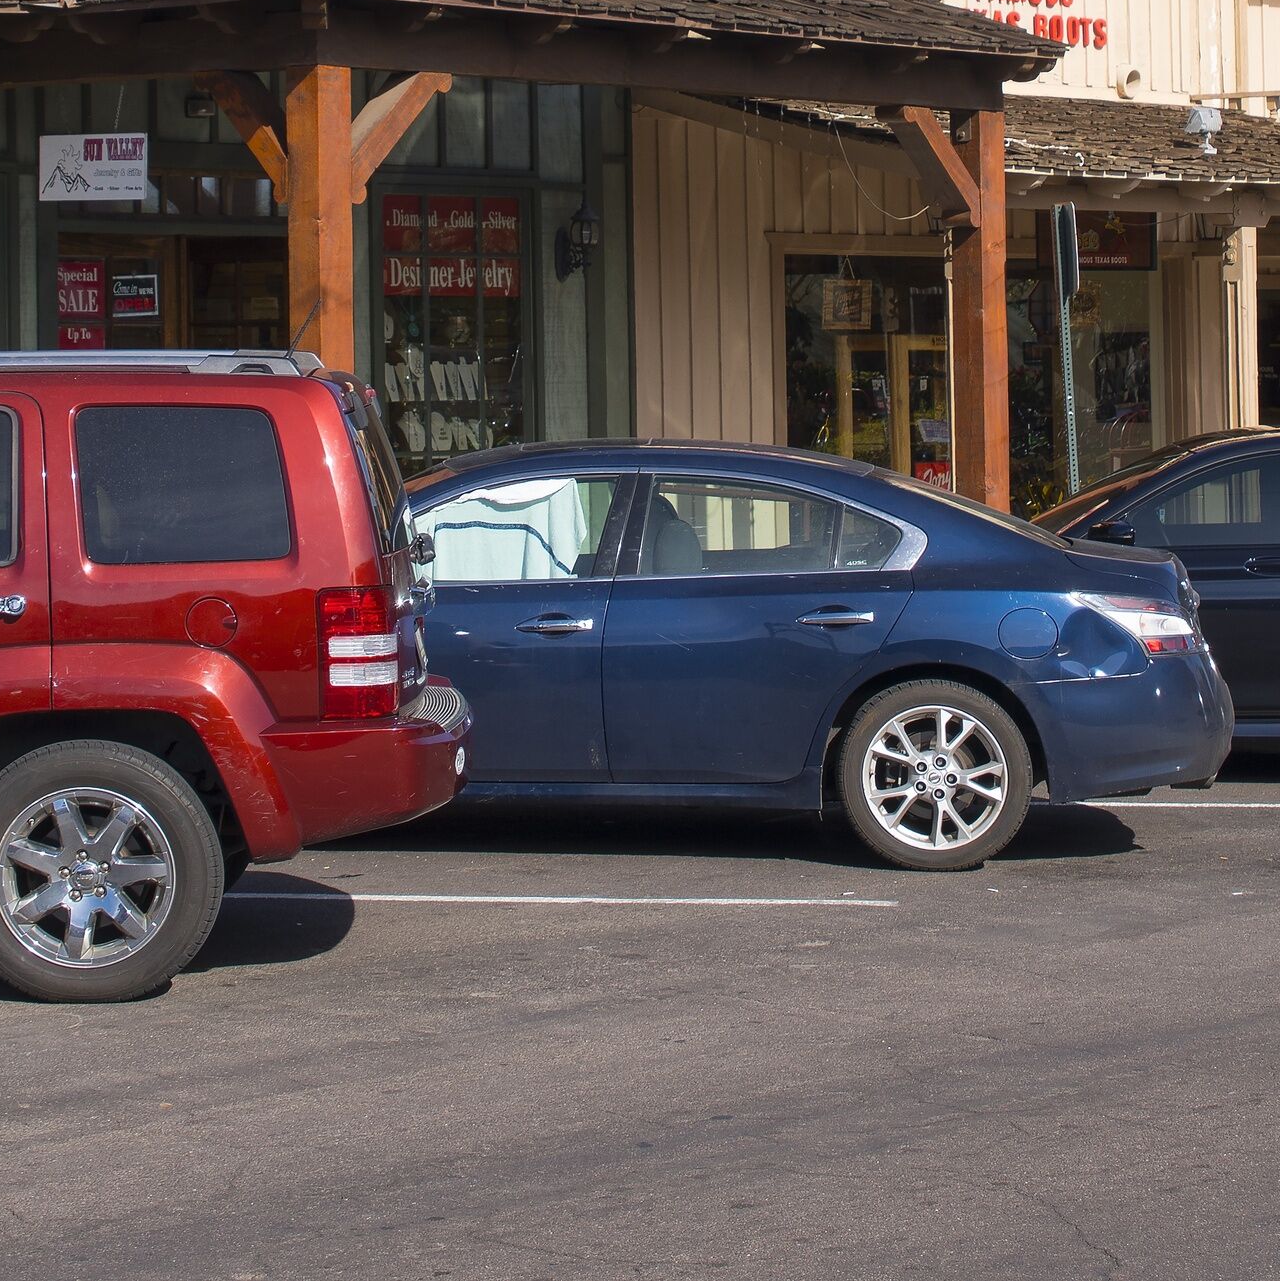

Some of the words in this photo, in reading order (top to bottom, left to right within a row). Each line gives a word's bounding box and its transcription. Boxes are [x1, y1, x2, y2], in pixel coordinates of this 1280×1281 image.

[1033, 14, 1108, 50] BOOTS
[83, 138, 103, 161] SUN
[106, 137, 145, 161] VALLEY
[450, 210, 474, 229] Gold
[488, 211, 517, 230] Silver
[1094, 256, 1110, 264] TEXAS
[1110, 256, 1127, 264] BOOTS
[57, 267, 98, 286] Special
[390, 258, 454, 288] Desiner
[58, 289, 98, 313] SALE
[67, 328, 79, 344] Up
[80, 328, 91, 340] To
